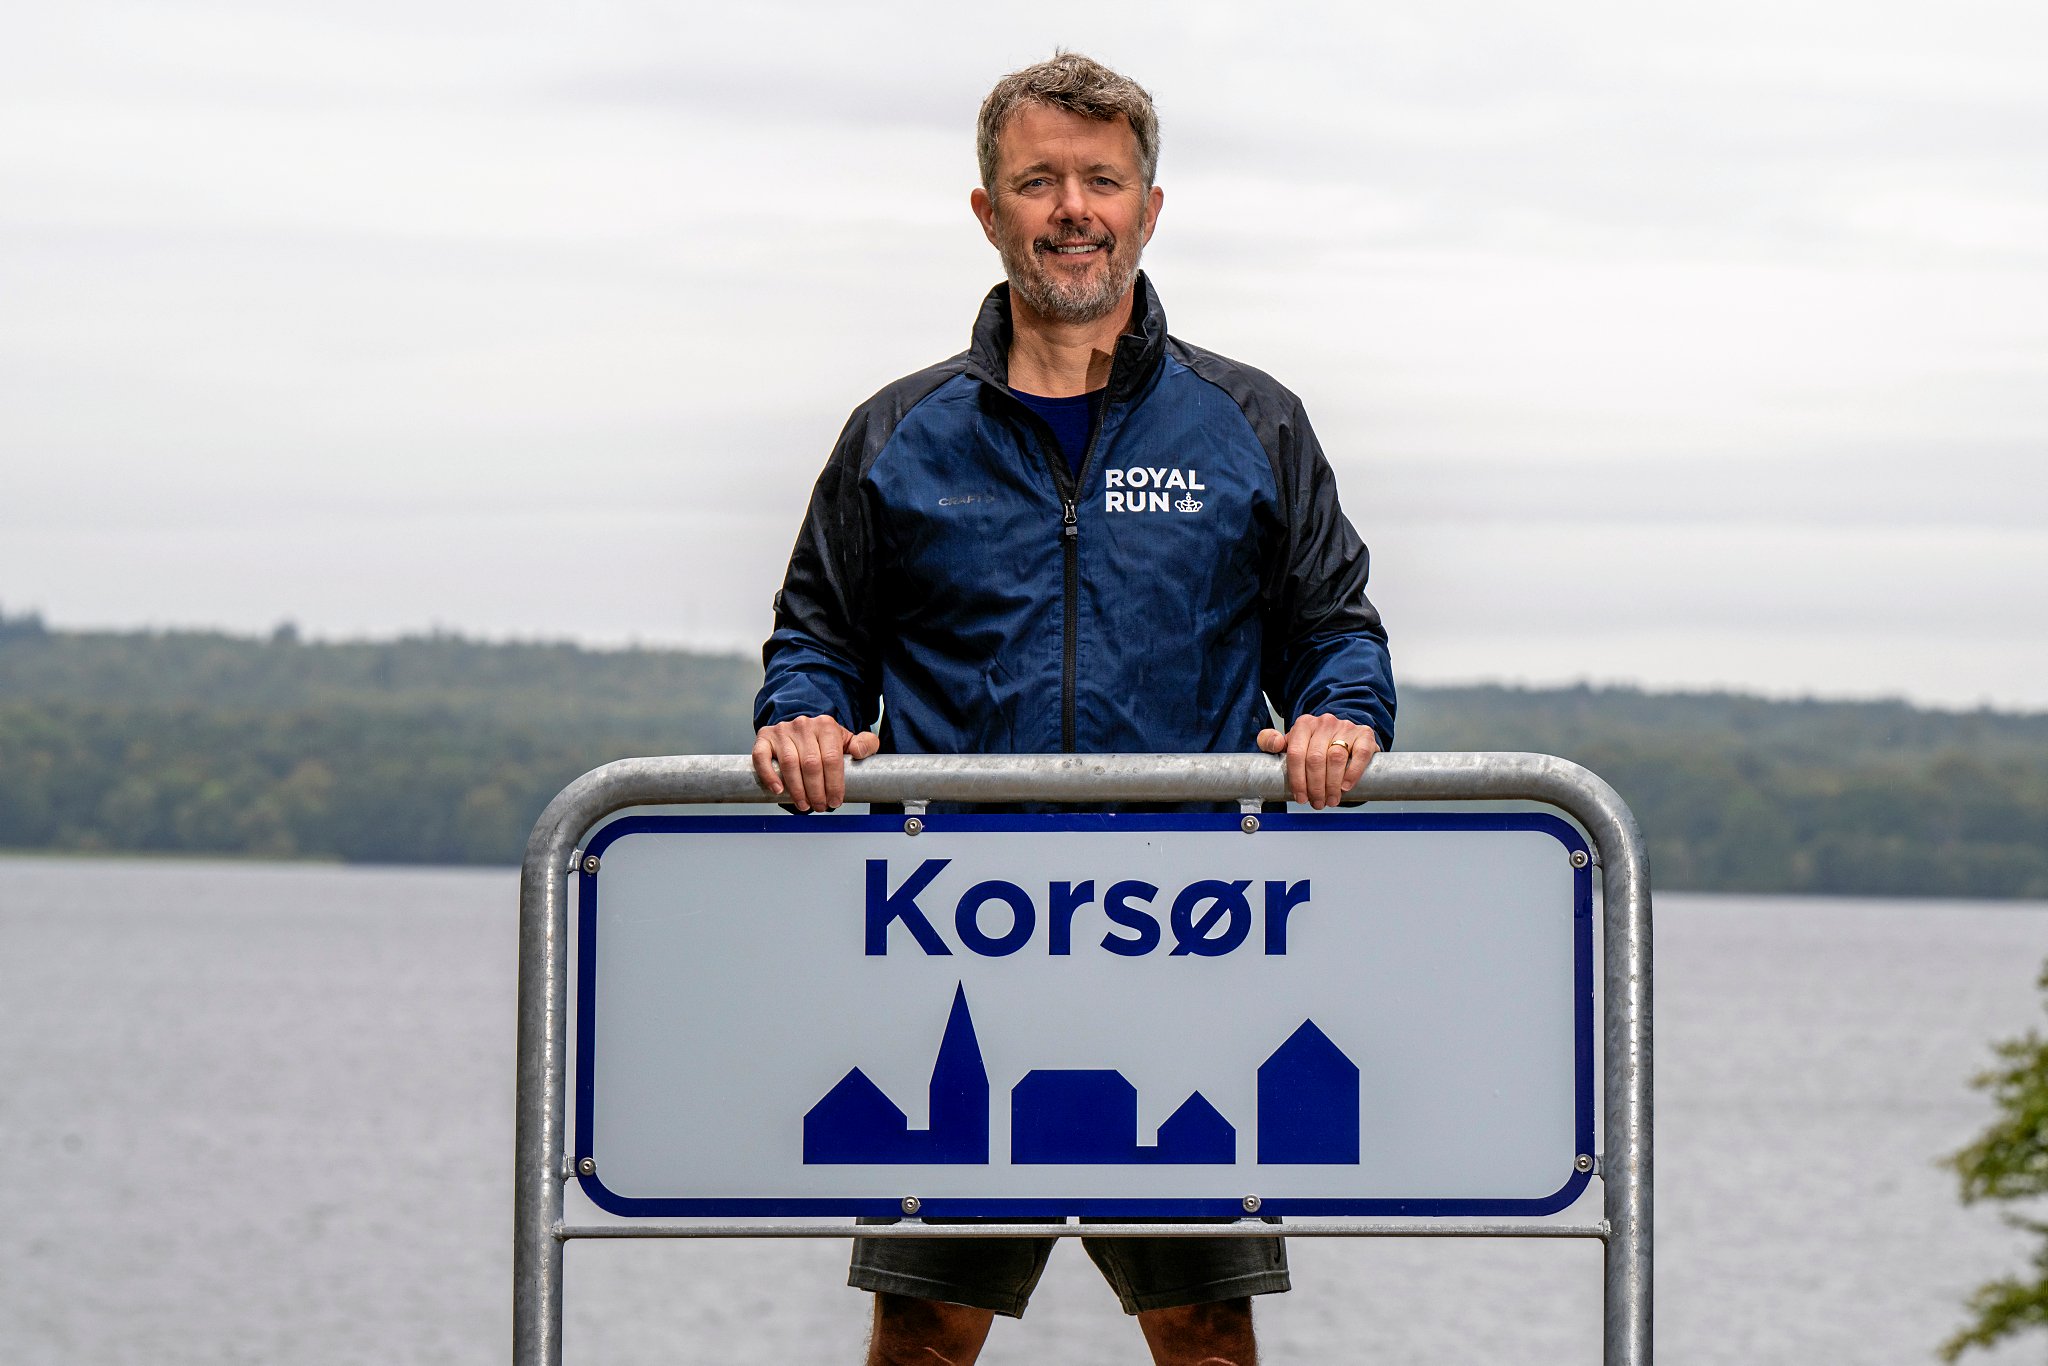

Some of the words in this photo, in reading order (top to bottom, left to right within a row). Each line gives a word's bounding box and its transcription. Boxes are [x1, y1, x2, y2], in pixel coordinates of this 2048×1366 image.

[1105, 466, 1206, 490] ROYAL
[1105, 491, 1170, 513] RUN
[865, 858, 1311, 957] Korsør
